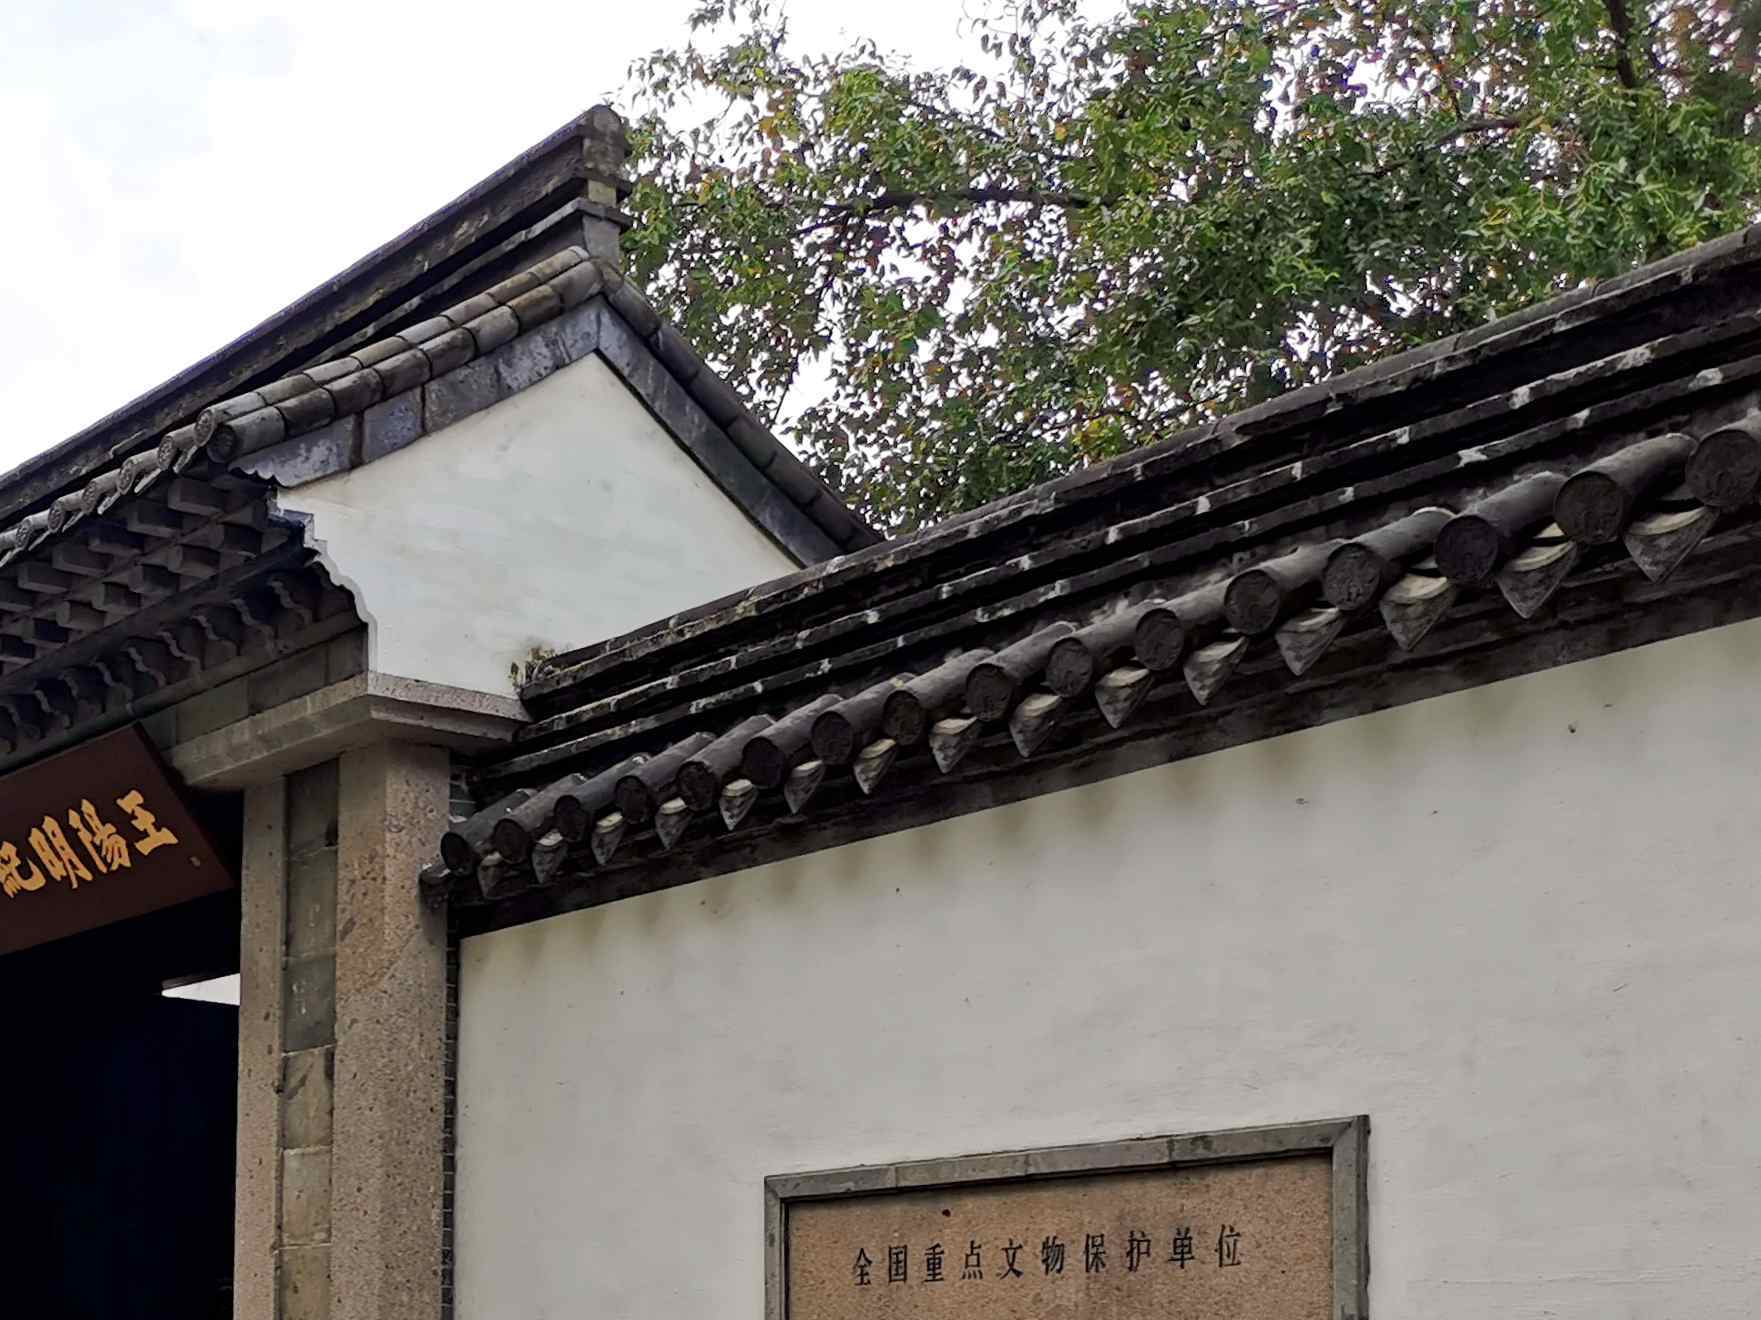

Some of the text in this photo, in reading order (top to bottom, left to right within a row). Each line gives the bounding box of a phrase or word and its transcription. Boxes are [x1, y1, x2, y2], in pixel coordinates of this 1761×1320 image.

[852, 1223, 1241, 1287] 全国重点文物保护单位
